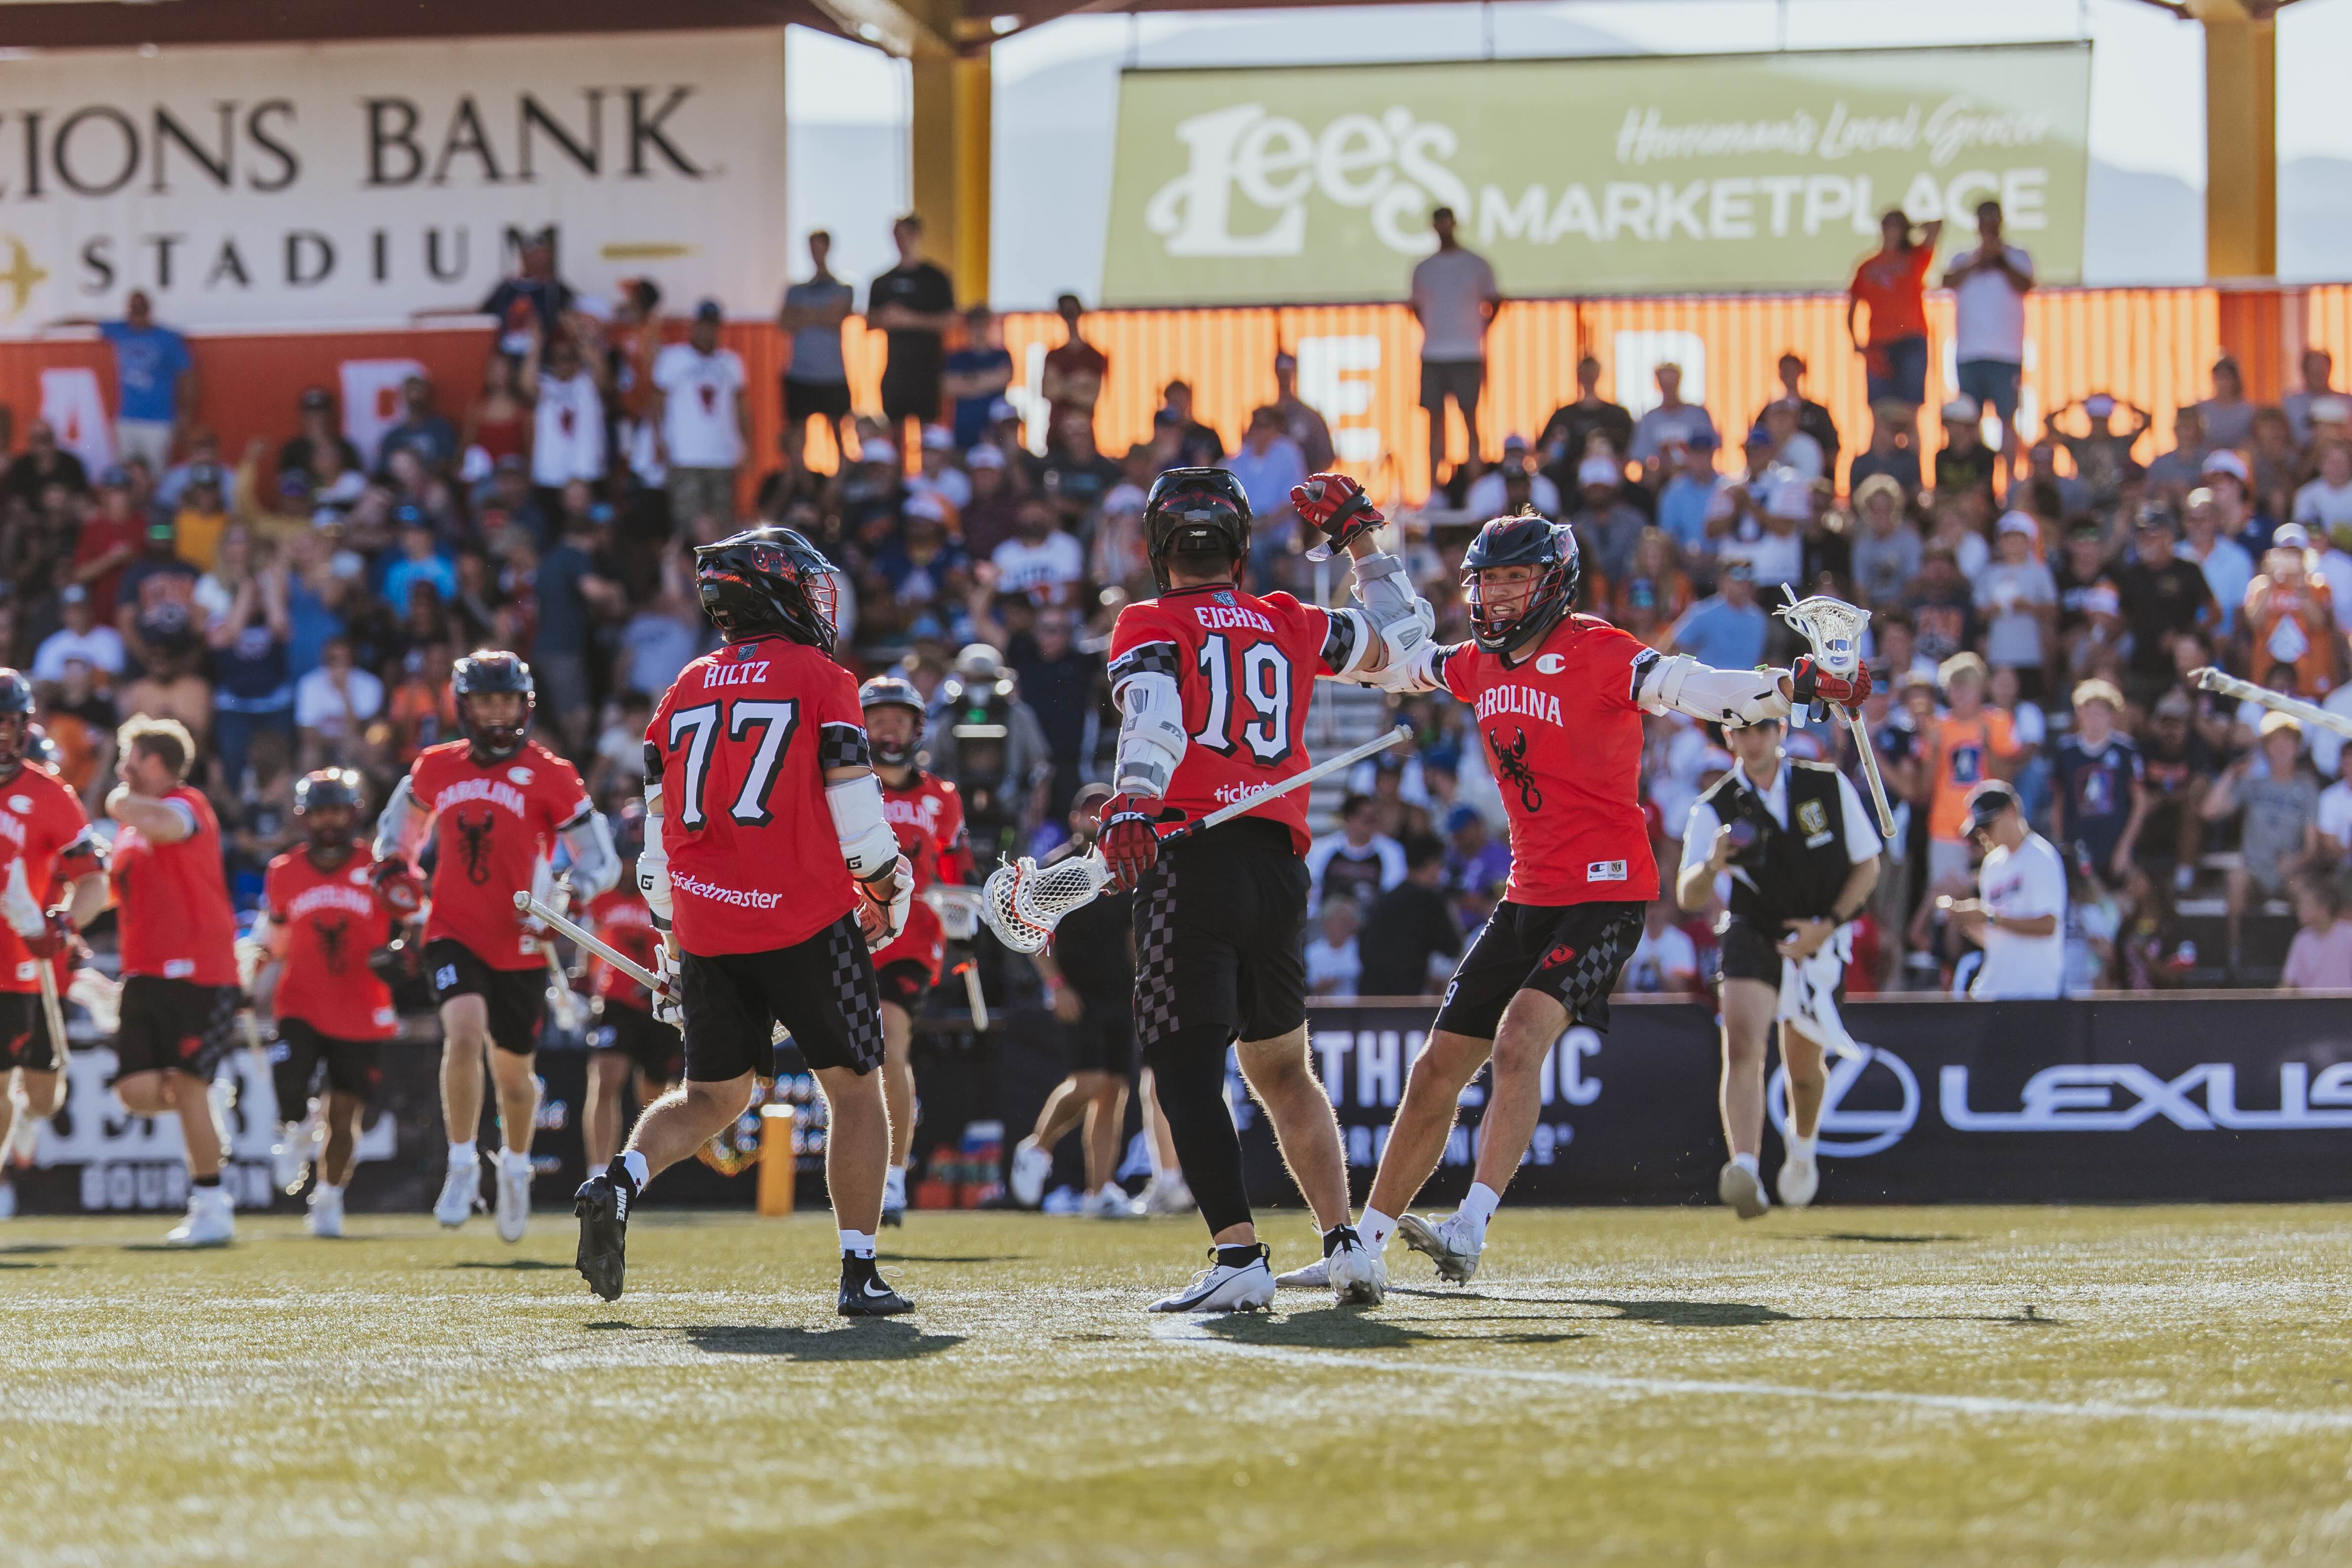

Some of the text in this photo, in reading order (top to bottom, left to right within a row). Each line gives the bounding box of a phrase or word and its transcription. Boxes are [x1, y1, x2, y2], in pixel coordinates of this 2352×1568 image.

[0, 83, 704, 201] IONS BANK
[1145, 102, 1475, 256] Lee's
[1476, 167, 2051, 245] MARKETPLACE
[1193, 607, 1275, 633] EICHER
[703, 661, 771, 689] HILTZ
[1191, 632, 1292, 768] 19
[1158, 720, 1185, 742] STX
[668, 697, 799, 833] 77
[1110, 811, 1146, 825] STX
[671, 870, 783, 908] ticketmaster
[80, 1165, 275, 1211] BOURON
[614, 1185, 627, 1222] NIKE
